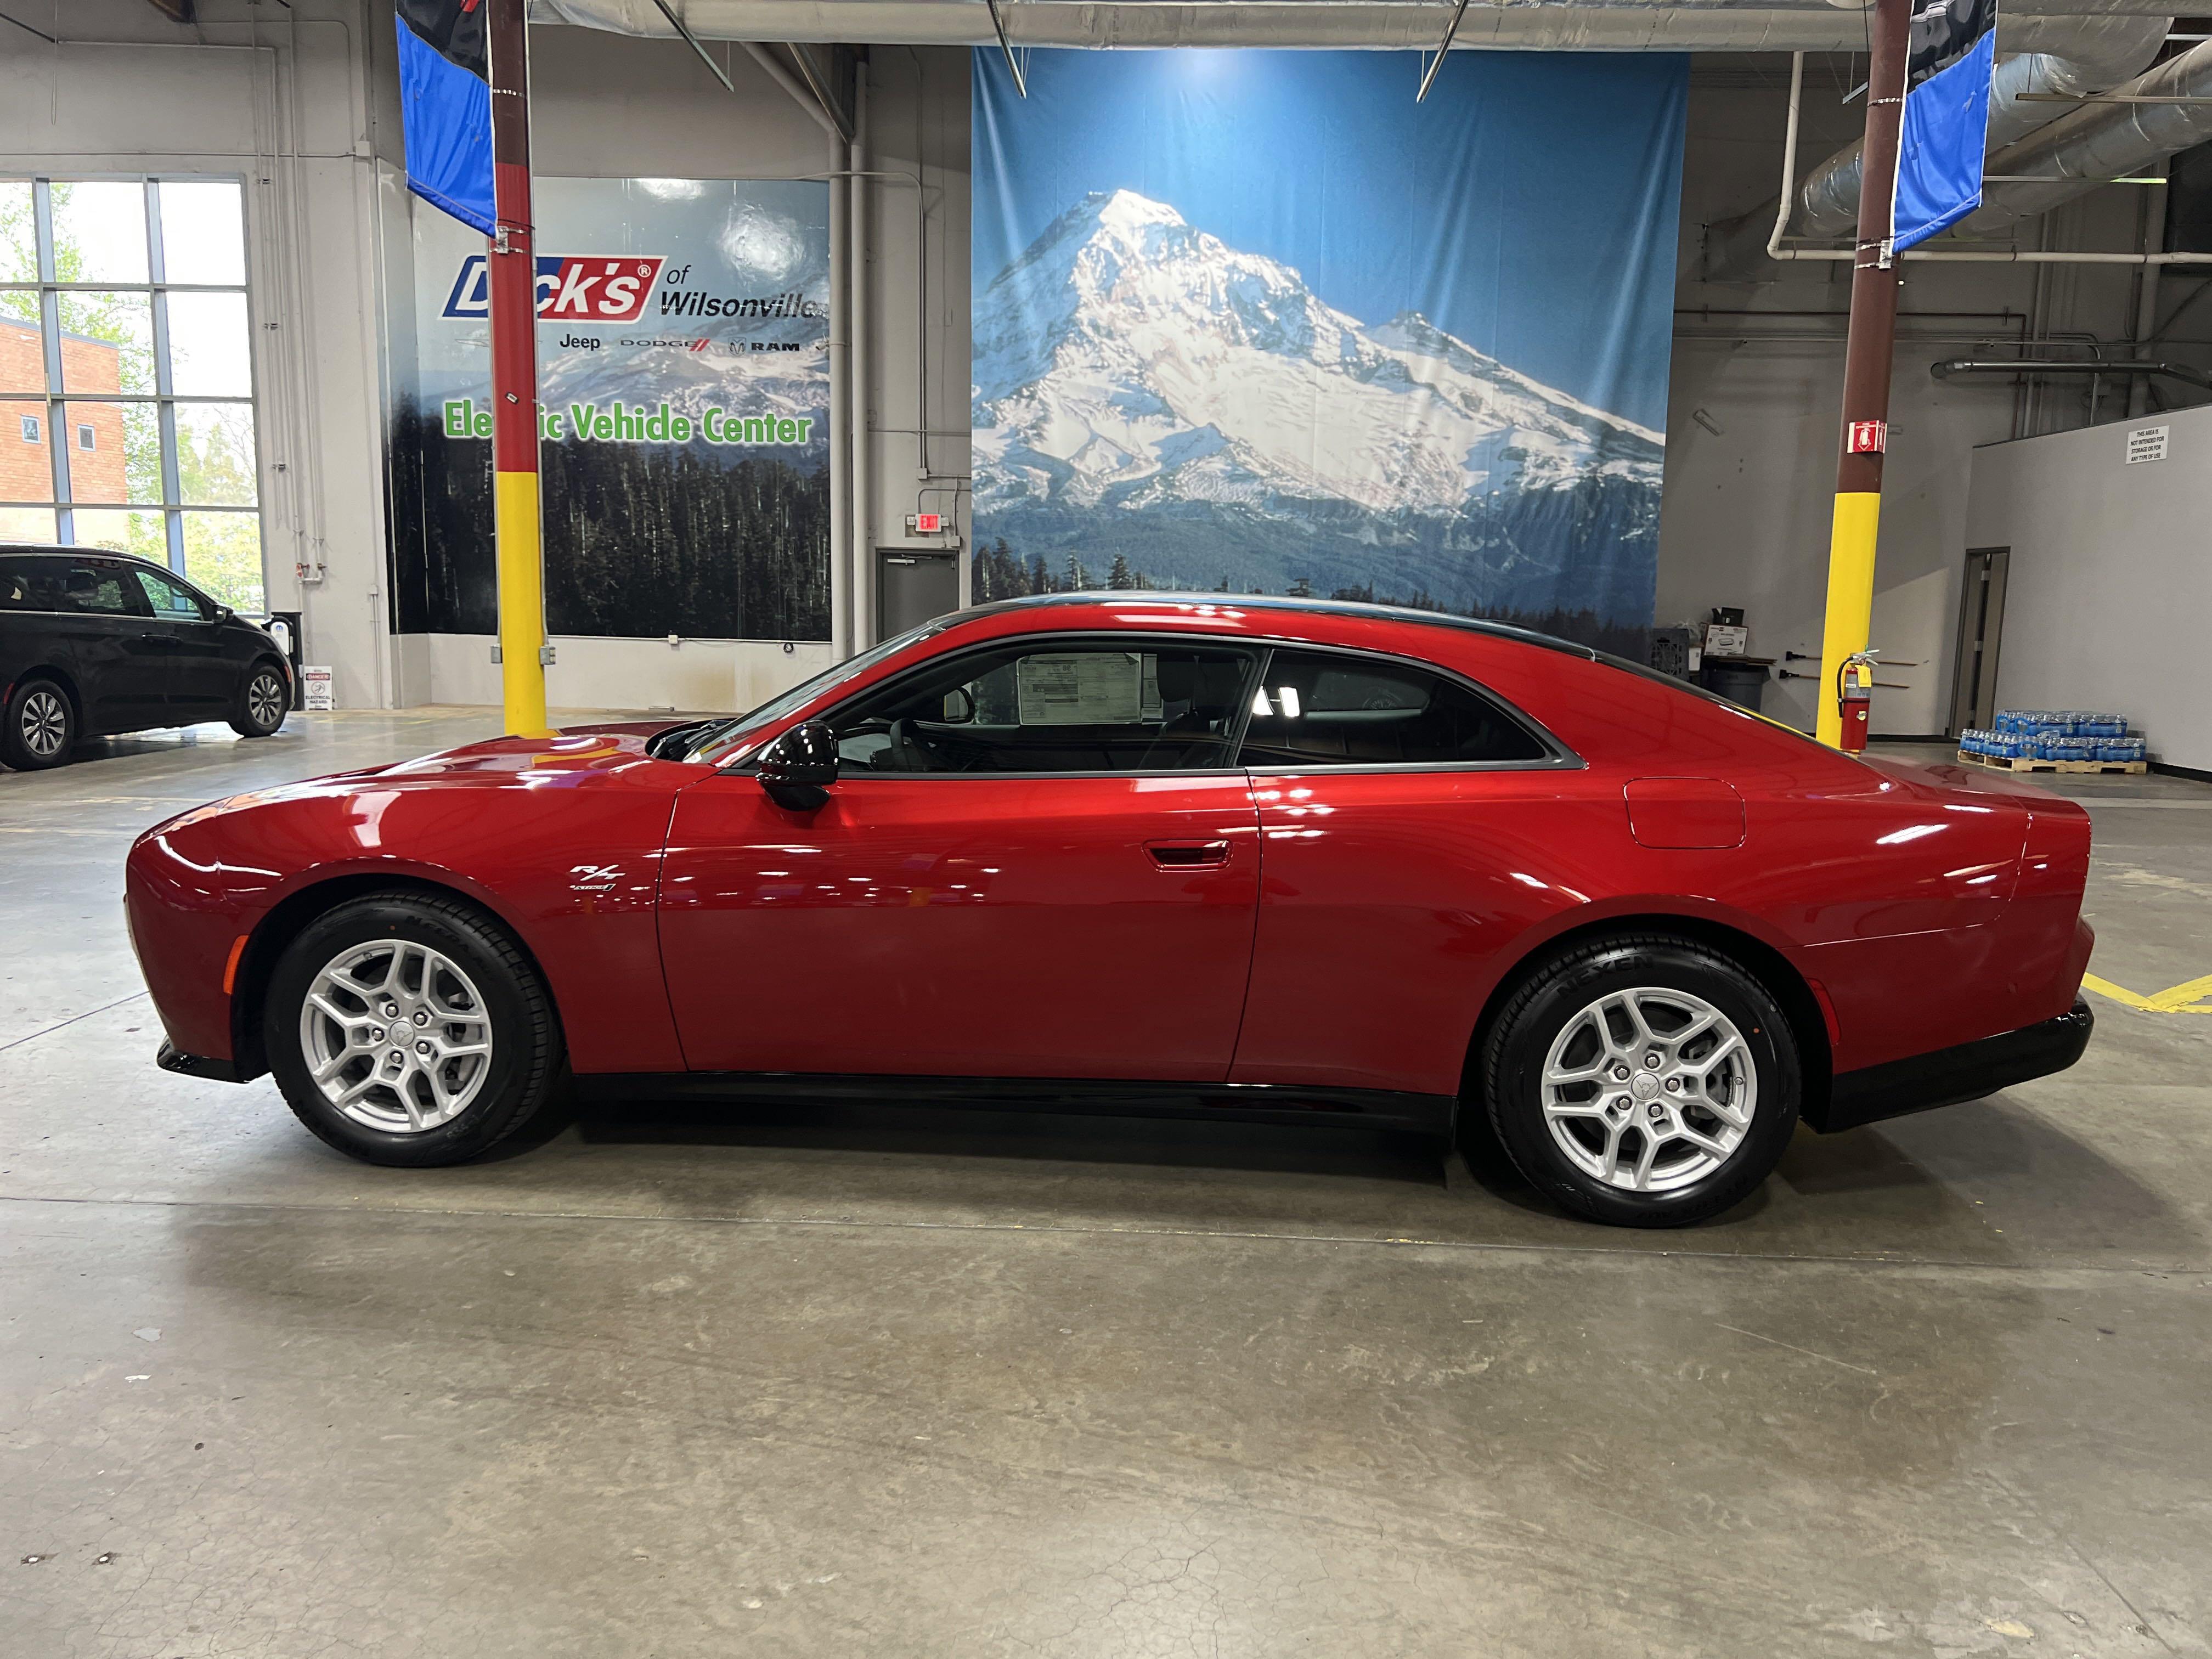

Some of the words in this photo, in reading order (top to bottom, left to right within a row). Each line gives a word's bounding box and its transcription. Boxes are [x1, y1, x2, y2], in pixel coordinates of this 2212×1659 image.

[667, 264, 691, 284] of
[661, 291, 817, 318] Wilsonville
[560, 334, 600, 351] Jeep
[751, 342, 800, 352] RAM
[445, 400, 562, 438] Eleic
[571, 403, 690, 441] Vehicle
[704, 408, 812, 443] Center
[921, 515, 939, 529] EXIT
[1557, 956, 1654, 999] NEXEN
